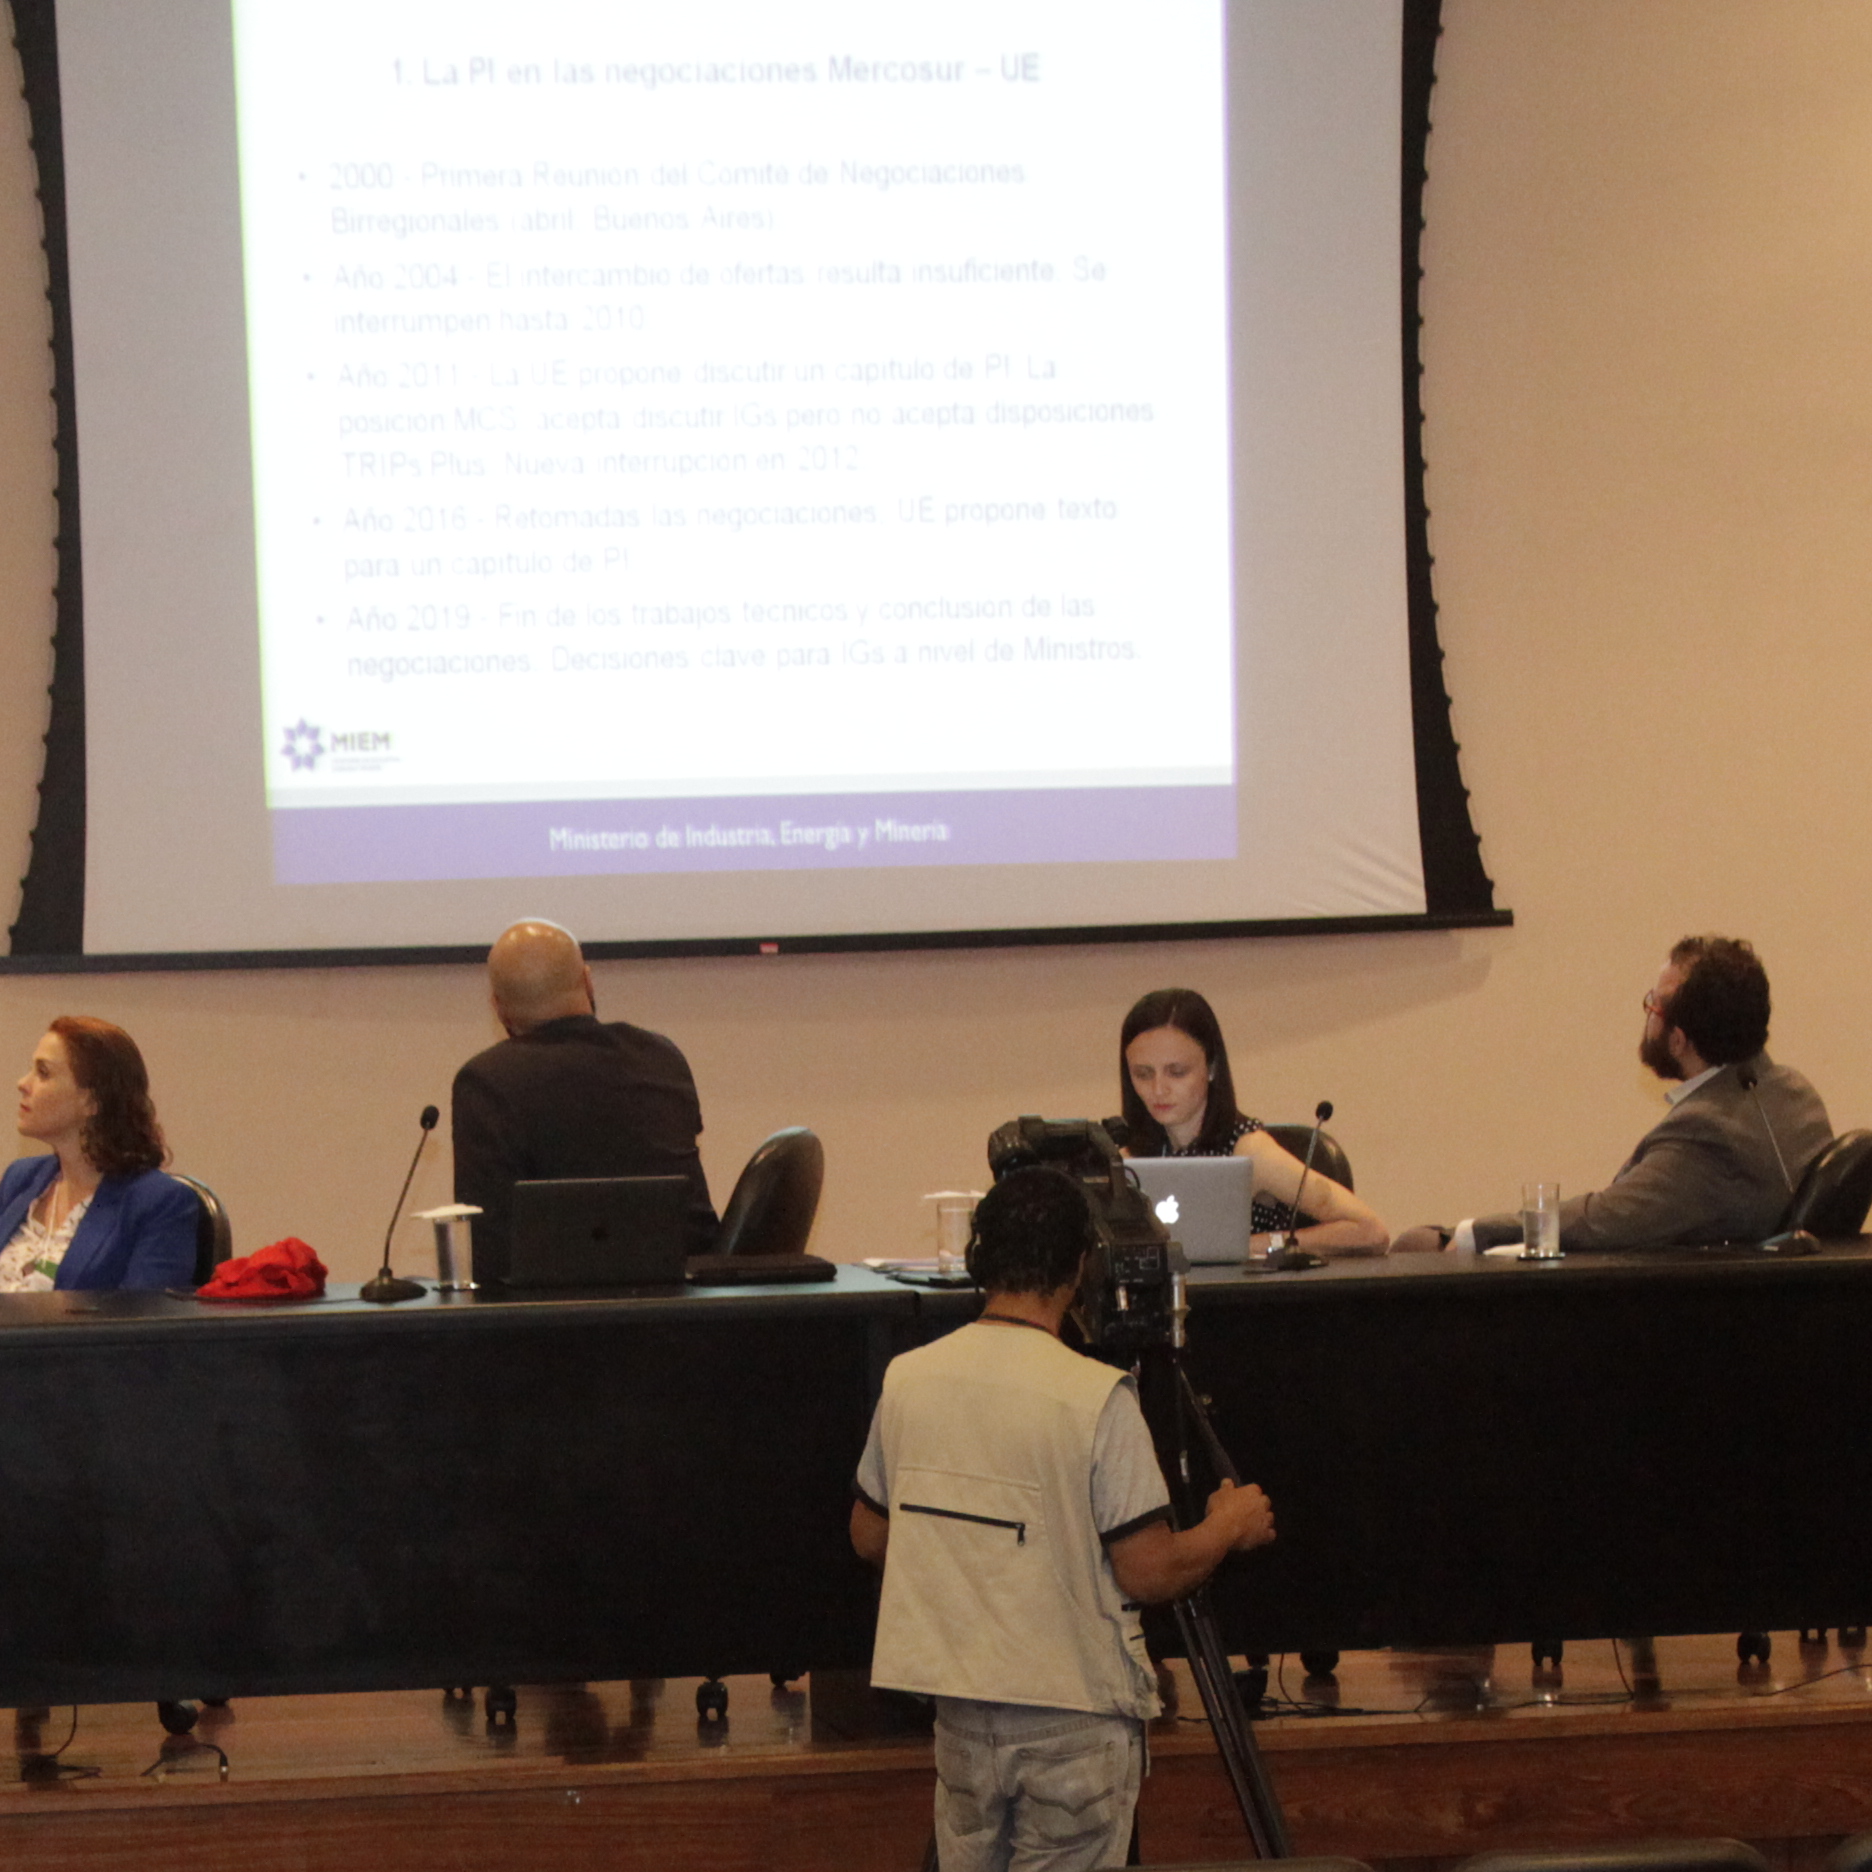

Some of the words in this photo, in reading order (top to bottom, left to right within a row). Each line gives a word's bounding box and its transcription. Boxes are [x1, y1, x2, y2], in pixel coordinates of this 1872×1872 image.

[392, 56, 412, 86] 1.
[422, 56, 462, 87] La
[468, 55, 497, 86] PI
[506, 62, 544, 86] en
[553, 57, 597, 86] las
[603, 58, 820, 91] negociaciones
[828, 53, 967, 84] Mercosur
[1000, 50, 1043, 85] UE
[329, 161, 395, 191] 2000
[421, 160, 524, 188] Primera
[651, 162, 690, 187] del
[798, 160, 831, 186] de
[840, 159, 1029, 193] Negociaciones
[331, 205, 500, 241] Birregionales
[594, 204, 690, 232] Buenos
[334, 263, 385, 291] Año
[394, 262, 460, 291] 2004
[487, 261, 511, 289] El
[521, 263, 672, 288] intercambio
[680, 262, 711, 286] de
[720, 260, 806, 286] ofertas
[818, 259, 904, 285] resulta
[1073, 254, 1109, 283] Se
[335, 310, 491, 337] interrumpen
[500, 309, 569, 332] hasta
[338, 362, 389, 389] Año
[398, 361, 457, 389] 2011
[491, 364, 520, 387] La
[531, 358, 568, 386] UE
[579, 365, 682, 389] propone
[694, 360, 787, 384] discutir
[794, 362, 826, 382] un
[943, 356, 975, 381] de
[1027, 354, 1059, 381] La
[537, 408, 621, 435] acepta
[633, 406, 725, 429] discutir
[734, 401, 778, 428] IGs
[786, 407, 841, 432] pero
[851, 406, 882, 426] no
[892, 401, 978, 430] acepta
[985, 399, 1158, 430] disposiciones
[341, 450, 423, 478] TRIPs
[505, 451, 585, 475] Nueva
[756, 452, 786, 471] en
[343, 506, 395, 533] Año
[404, 504, 468, 533] 2016
[495, 503, 641, 530] Retomadas
[652, 504, 687, 527] las
[898, 494, 936, 524] UE
[944, 501, 1048, 528] propone
[1057, 496, 1120, 521] texto
[344, 557, 401, 584] para
[411, 556, 442, 576] un
[563, 550, 594, 573] de
[346, 605, 399, 632] Año
[406, 603, 472, 632] 2019
[499, 601, 537, 628] Fin
[546, 603, 577, 628] de
[587, 603, 622, 627] los
[631, 601, 732, 630] trabajos
[856, 604, 869, 627] y
[1021, 593, 1053, 619] de
[1061, 592, 1097, 618] las
[552, 644, 690, 672] Decisiones
[701, 644, 767, 668] clave
[777, 646, 832, 671] para
[842, 638, 886, 665] IGs
[894, 644, 910, 664] a
[918, 637, 977, 663] nivel
[984, 637, 1016, 663] de
[1023, 635, 1141, 662] Ministros.
[331, 732, 391, 753] MIEM
[549, 826, 650, 851] Ministerio
[655, 824, 681, 849] de
[685, 824, 777, 848] Industria,
[857, 826, 869, 851] y
